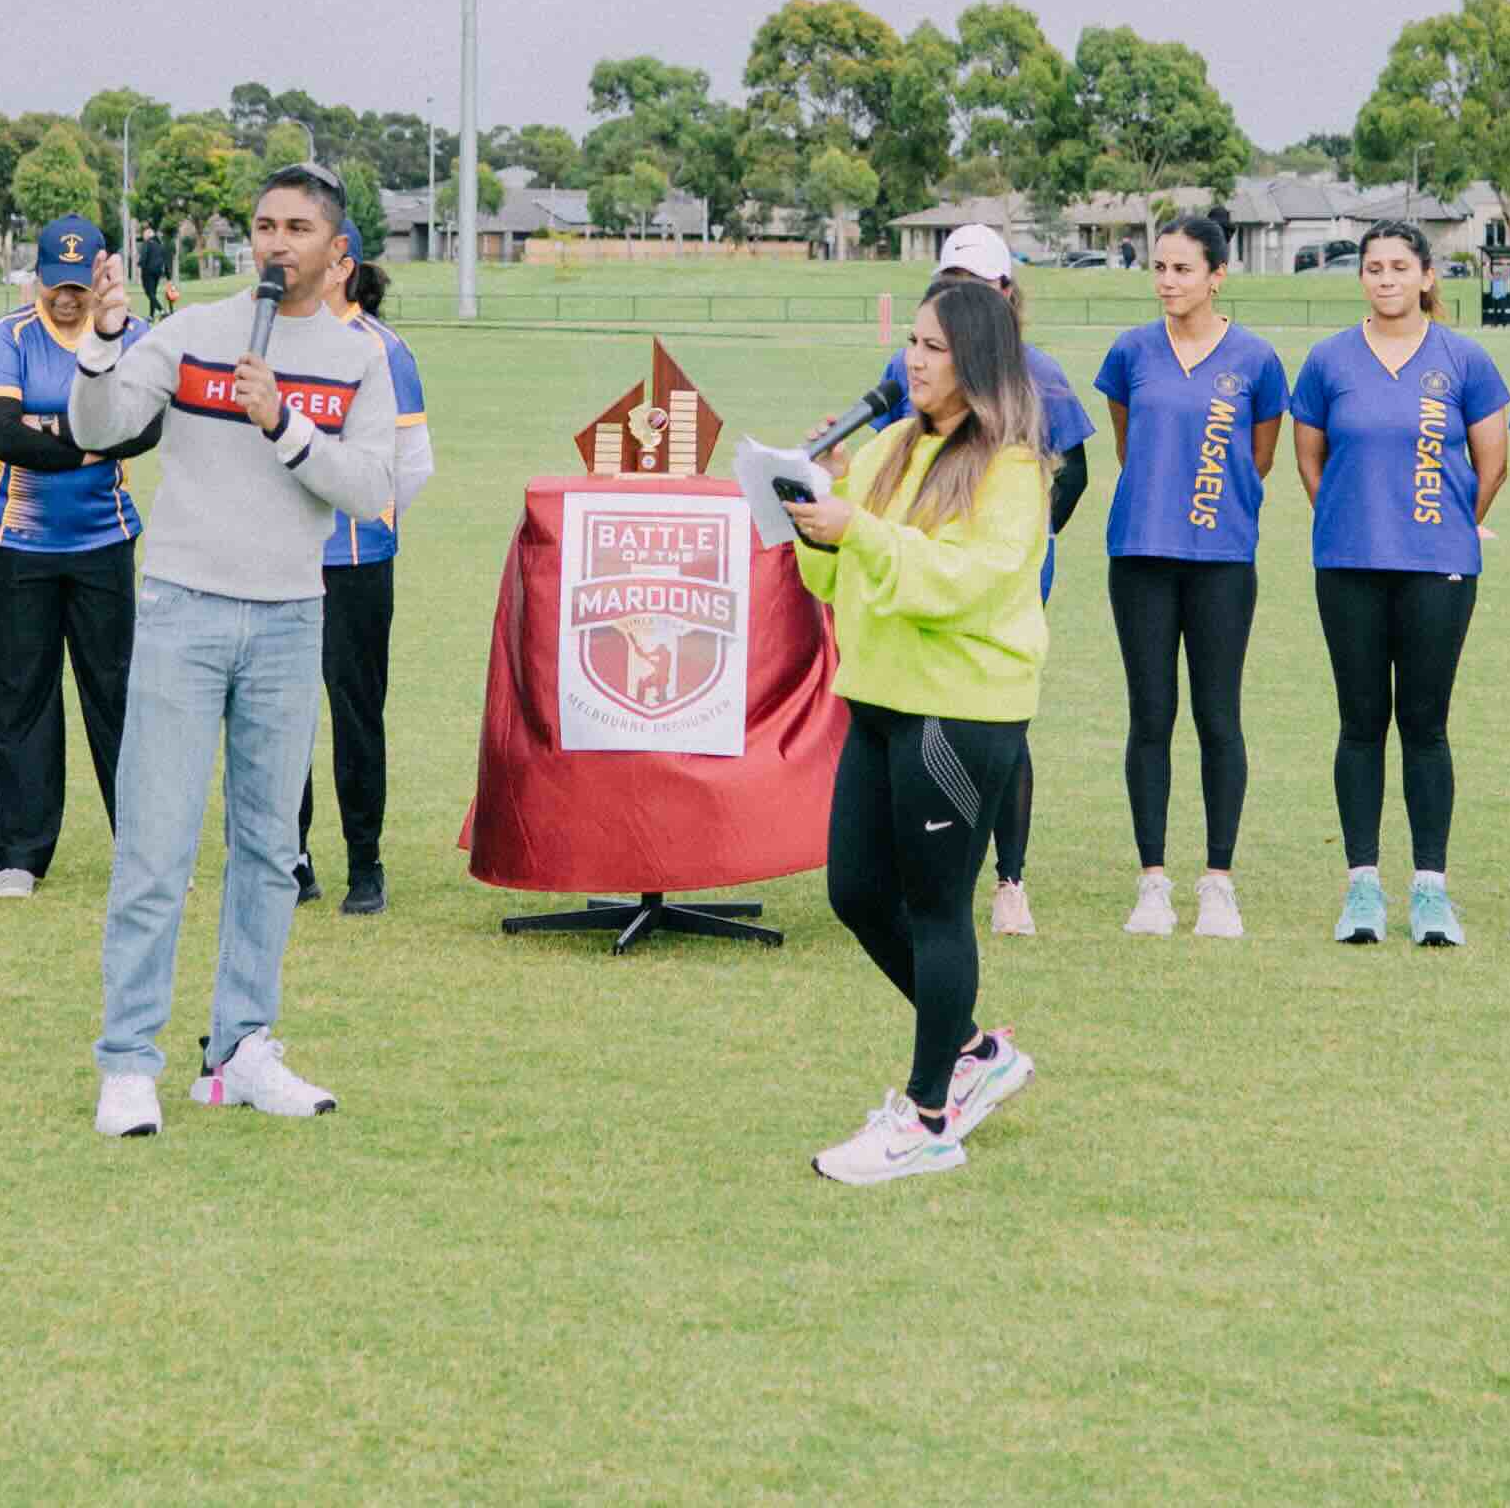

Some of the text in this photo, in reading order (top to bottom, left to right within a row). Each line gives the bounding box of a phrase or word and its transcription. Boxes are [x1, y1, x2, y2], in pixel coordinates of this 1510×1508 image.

[1189, 398, 1236, 530] MUSAEUS
[1413, 396, 1446, 525] MUSAEUS
[598, 524, 713, 550] BATTLE
[622, 550, 694, 563] OF THE
[578, 585, 730, 621] MAROONS
